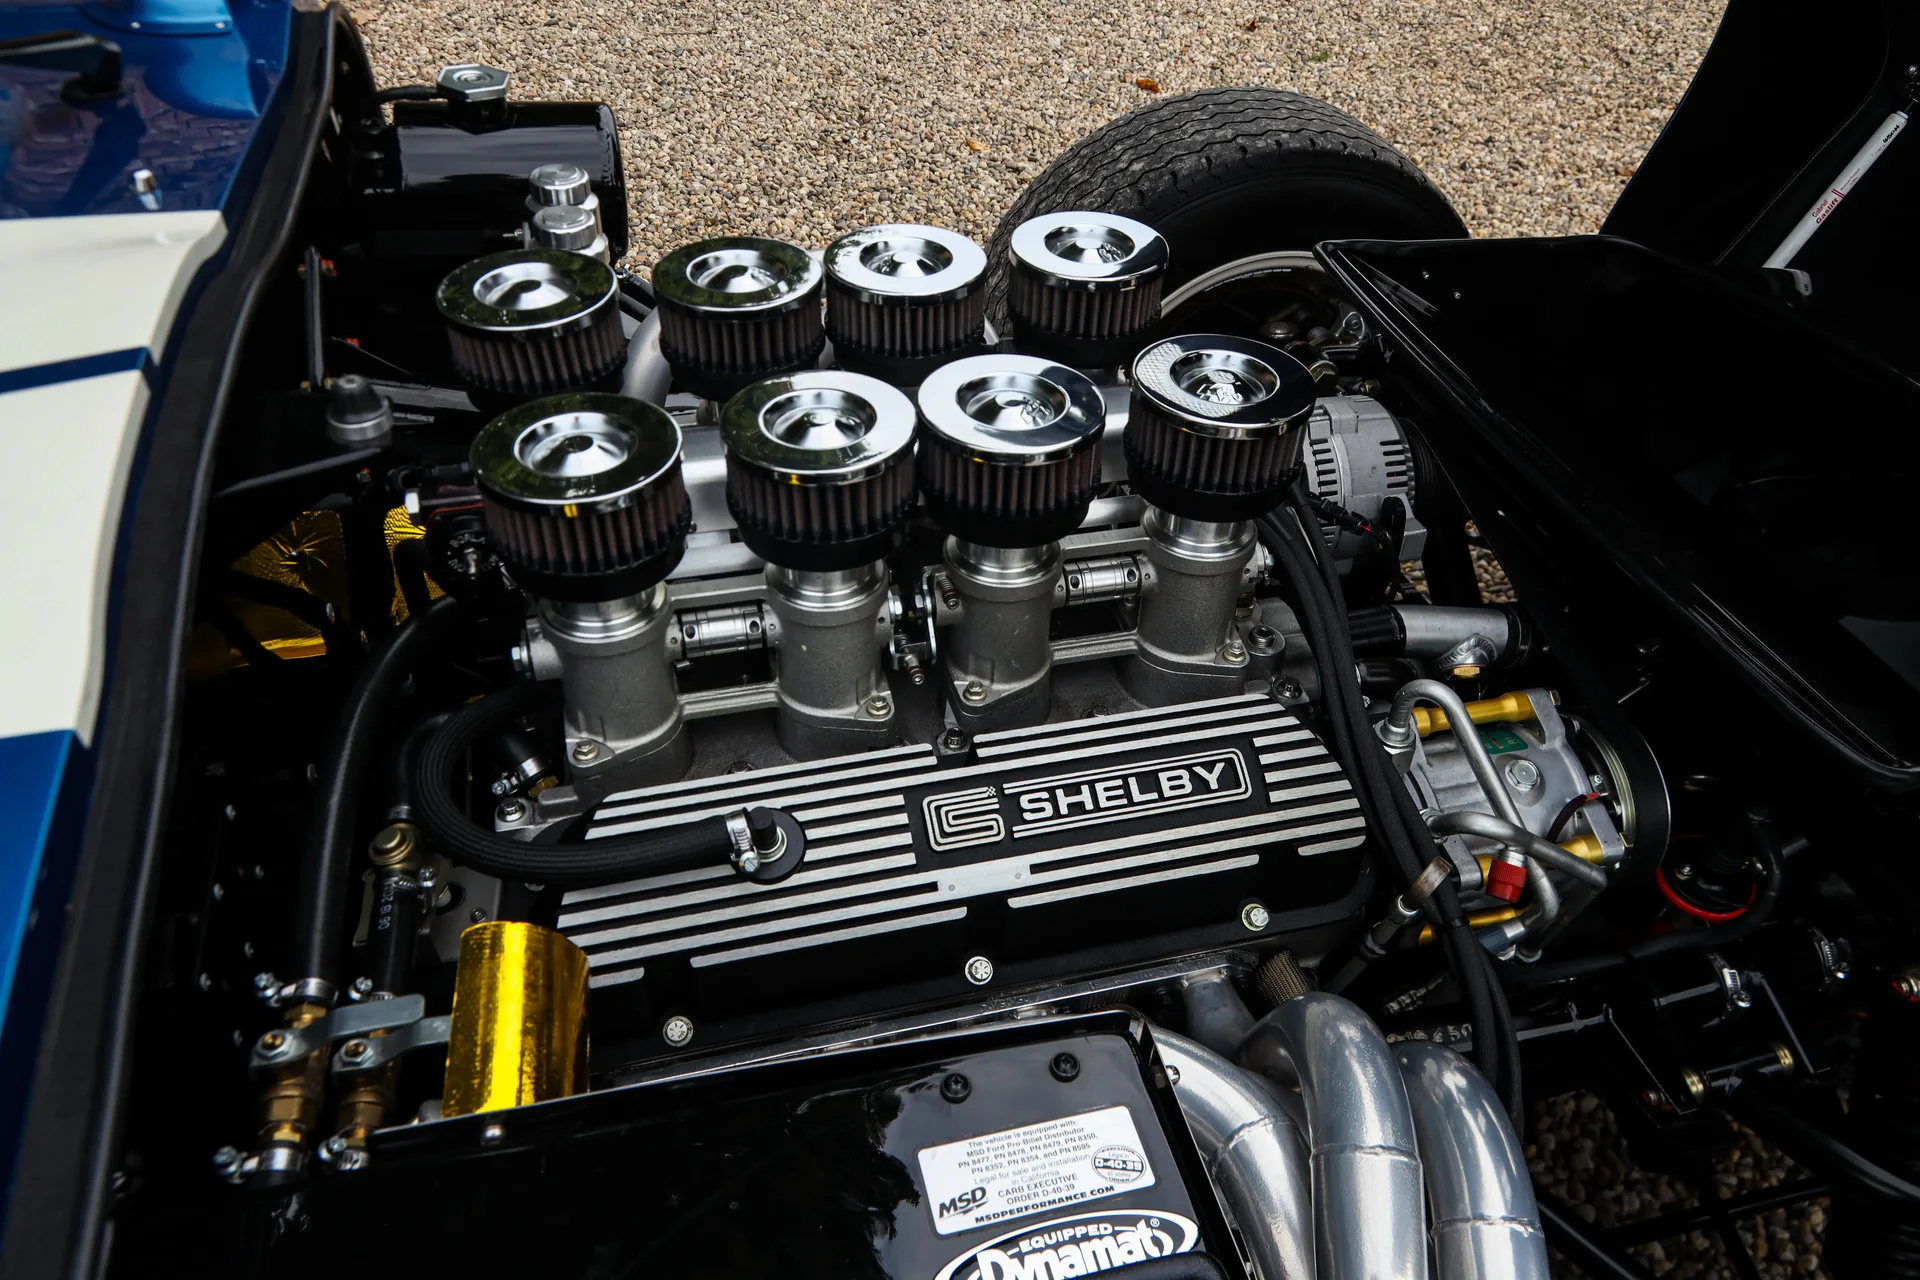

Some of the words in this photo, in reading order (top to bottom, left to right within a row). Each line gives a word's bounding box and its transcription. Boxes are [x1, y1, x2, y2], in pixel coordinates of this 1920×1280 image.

[1812, 199, 1829, 217] Gabriel
[1815, 198, 1839, 224] Gaslift
[1019, 762, 1226, 821] SHELBY
[966, 1147, 985, 1158] MSD
[987, 1143, 1005, 1154] Ford
[1007, 1134, 1043, 1150] Pro-Billet
[1044, 1127, 1085, 1141] Distributor
[968, 1140, 983, 1149] The
[985, 1133, 1012, 1145] vehicle
[1014, 1132, 1021, 1140] is
[1023, 1123, 1058, 1138] equipped
[958, 1161, 970, 1169] PN
[994, 1152, 1006, 1161] PN
[1030, 1144, 1042, 1153] PN
[1064, 1135, 1077, 1144] PN
[971, 1167, 983, 1175] PN
[1007, 1158, 1019, 1167] PN
[1043, 1150, 1058, 1160] and
[1059, 1147, 1071, 1155] PN
[1108, 1151, 1124, 1160] Legal
[974, 1174, 998, 1187] Legal
[998, 1169, 1010, 1179] for
[1012, 1166, 1029, 1177] sale
[1031, 1161, 1047, 1172] and
[1048, 1153, 1091, 1168] installation
[1020, 1170, 1060, 1184] California
[998, 1185, 1025, 1198] CARB
[1027, 1173, 1078, 1192] EXECUTIVE
[1006, 1191, 1040, 1205] ORDER
[1042, 1183, 1075, 1199] D-40-39
[938, 1186, 987, 1219] MSD
[974, 1185, 1115, 1224] MSDPERFORMANCE.COM
[1018, 1223, 1114, 1253] EQUIPPED
